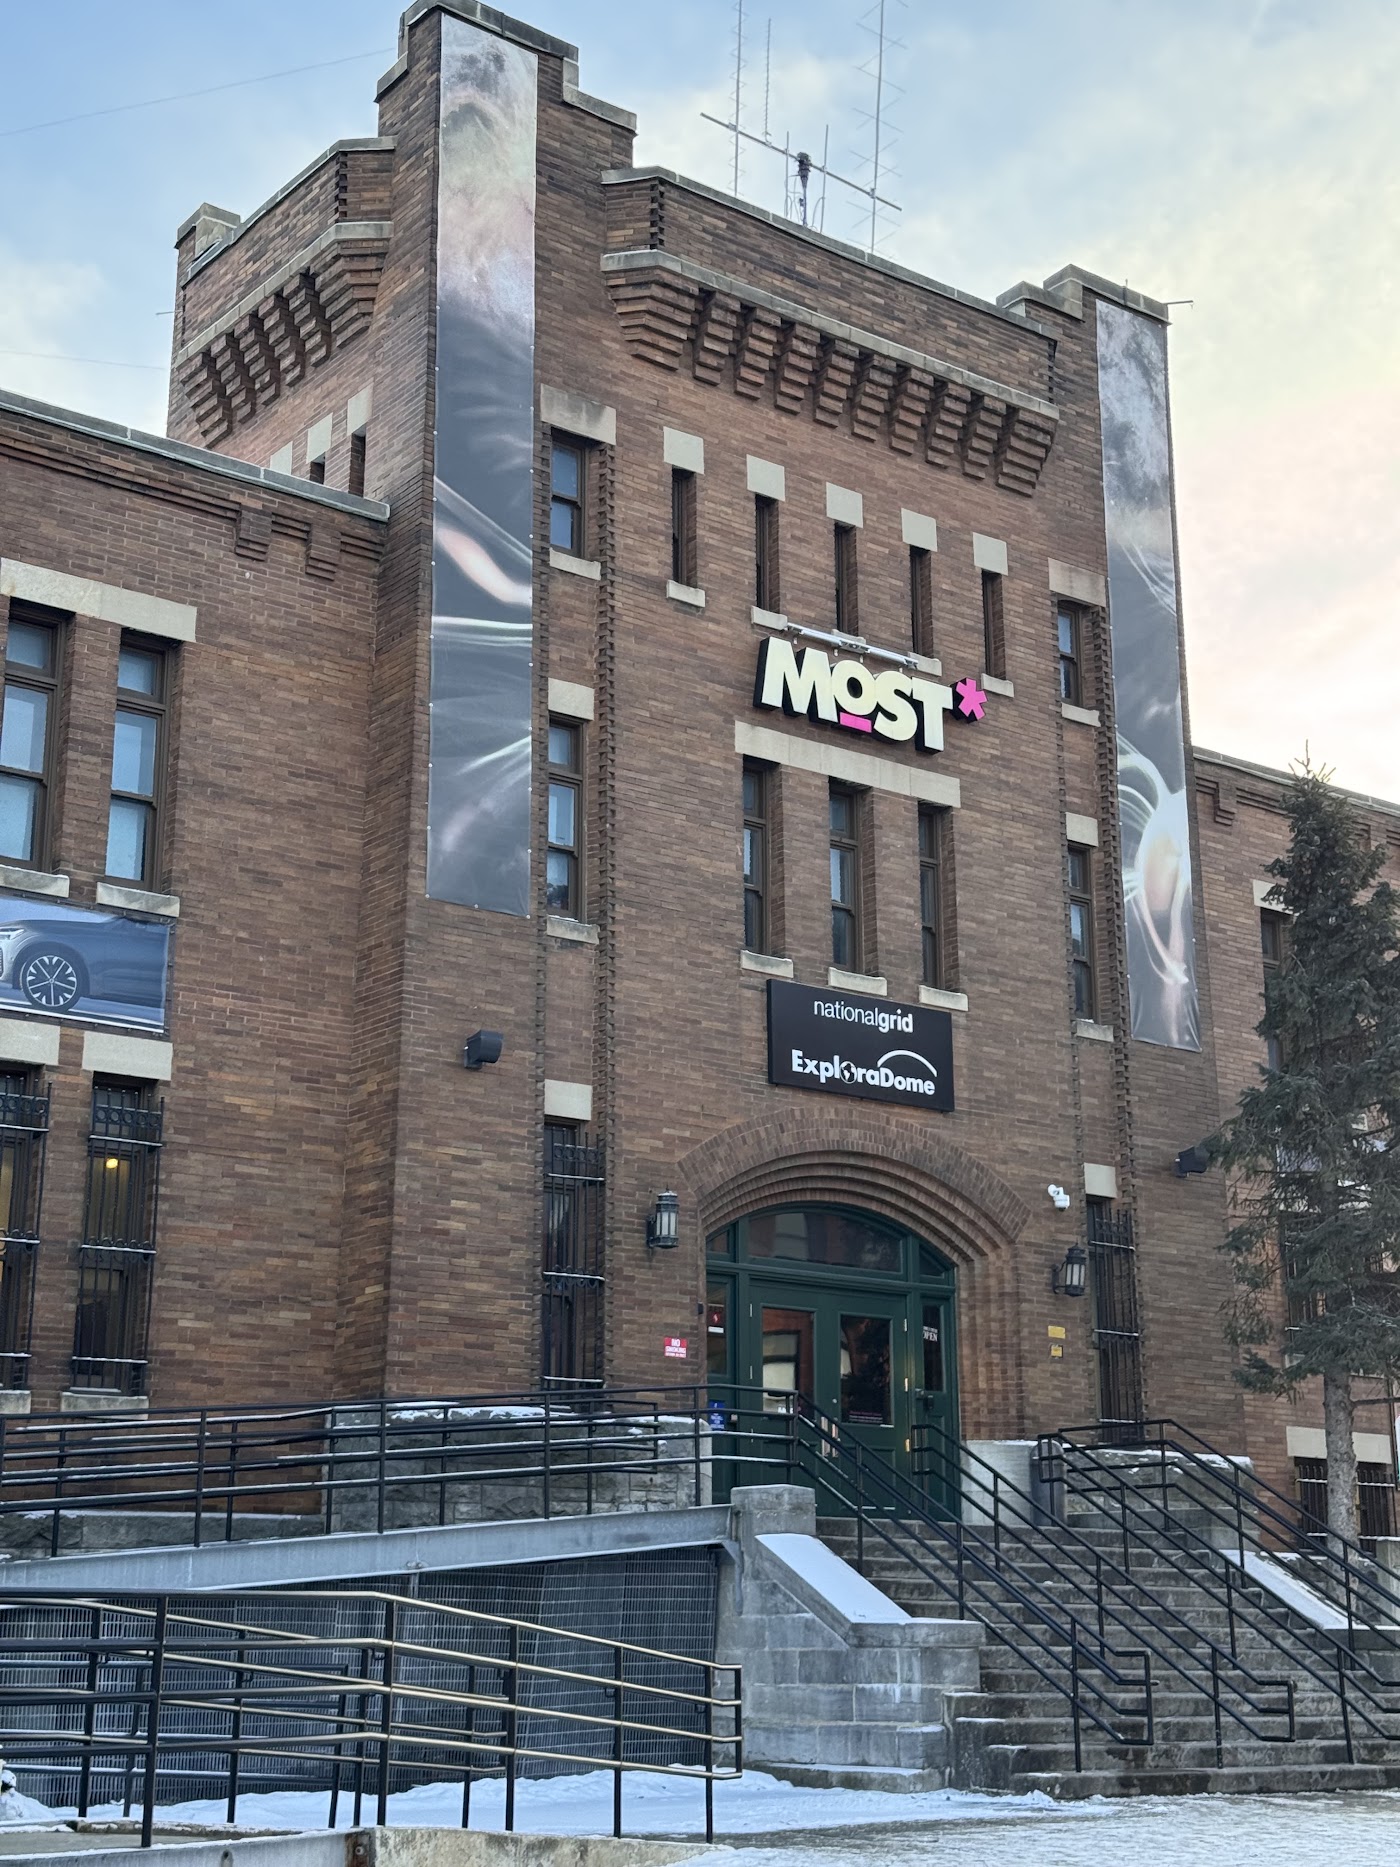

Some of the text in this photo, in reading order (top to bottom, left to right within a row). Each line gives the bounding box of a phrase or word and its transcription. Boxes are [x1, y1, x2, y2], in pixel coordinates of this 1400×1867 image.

[814, 1000, 914, 1034] nationalgrid
[791, 1049, 936, 1096] ExploraDome
[671, 1338, 681, 1347] NO
